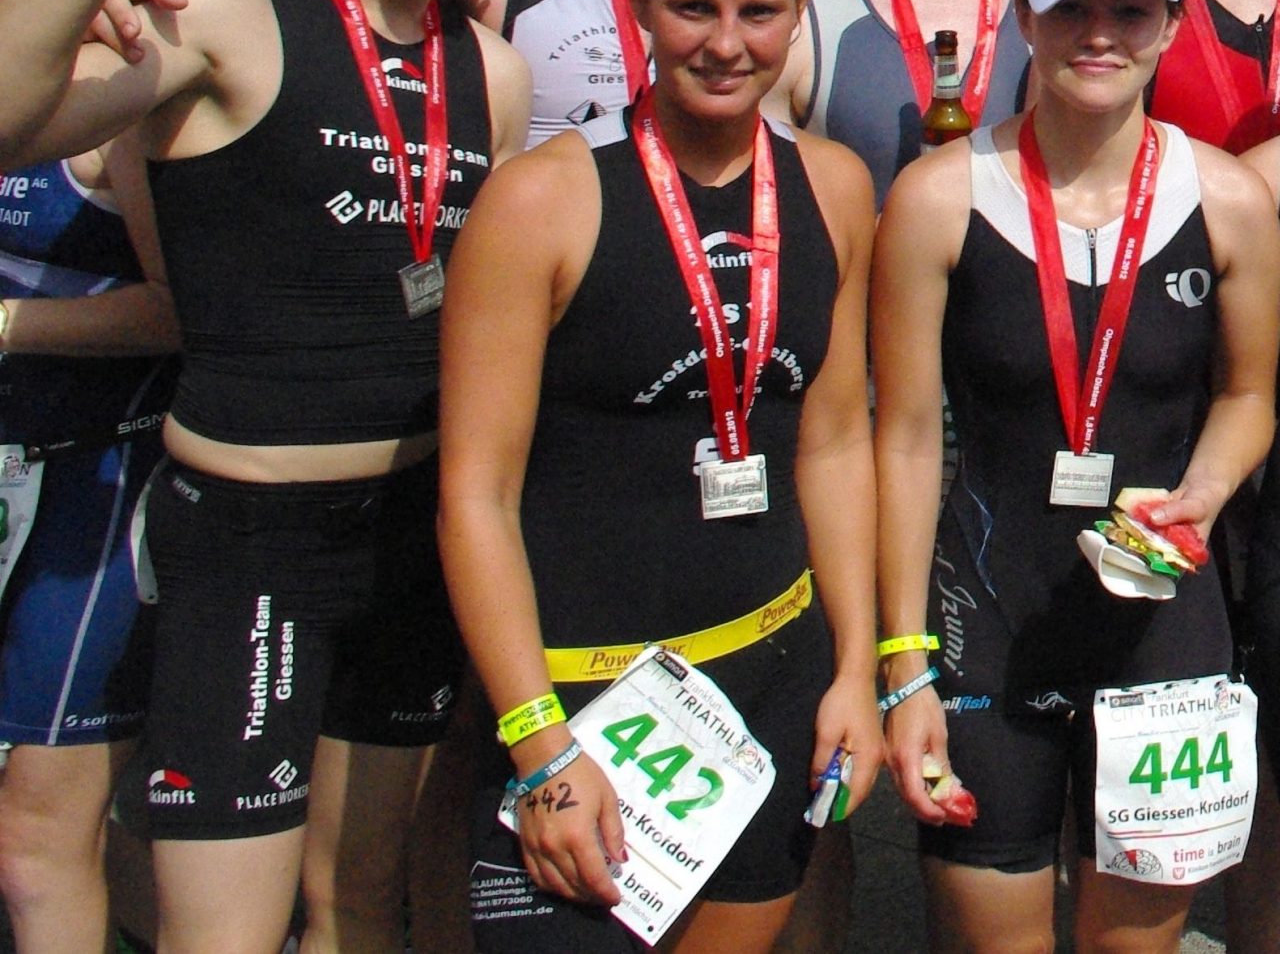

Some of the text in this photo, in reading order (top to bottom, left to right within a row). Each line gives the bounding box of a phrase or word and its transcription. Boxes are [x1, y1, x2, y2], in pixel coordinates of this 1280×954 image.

[549, 26, 617, 61] Triathlo
[386, 74, 427, 95] kinfit
[588, 74, 625, 84] Gies
[319, 128, 430, 155] Triaton
[1144, 149, 1153, 161] km
[32, 177, 48, 189] AG
[371, 156, 463, 182] Gisn
[1139, 179, 1147, 189] km
[367, 199, 471, 229] PLACEORK
[672, 207, 682, 220] km
[676, 220, 686, 233] 45
[1133, 207, 1142, 219] km
[682, 238, 693, 252] km
[1119, 237, 1136, 280] 05.08.2012
[707, 253, 753, 268] kinfi
[695, 272, 725, 357] Olympische Distanz
[756, 267, 769, 352] Olympische Distanz
[1095, 327, 1114, 376] Olympische
[1088, 376, 1103, 407] Distanz
[117, 412, 165, 434] SIGM
[725, 409, 739, 455] 05.08.2012
[1083, 427, 1092, 439] km
[936, 573, 977, 676] Izumi
[244, 595, 272, 740] Triathlon-Team
[275, 621, 295, 701] Giessen
[685, 676, 722, 712] Frankfurt
[942, 695, 992, 714] ailfish
[602, 713, 725, 821] 442
[1129, 731, 1233, 794] 444
[525, 783, 578, 814] 442
[1108, 790, 1249, 823] SG Giessen-Krofdorf
[617, 797, 704, 873] en-Krofdorf
[1174, 849, 1205, 863] time
[1217, 836, 1241, 854] brain
[623, 872, 663, 912] brain
